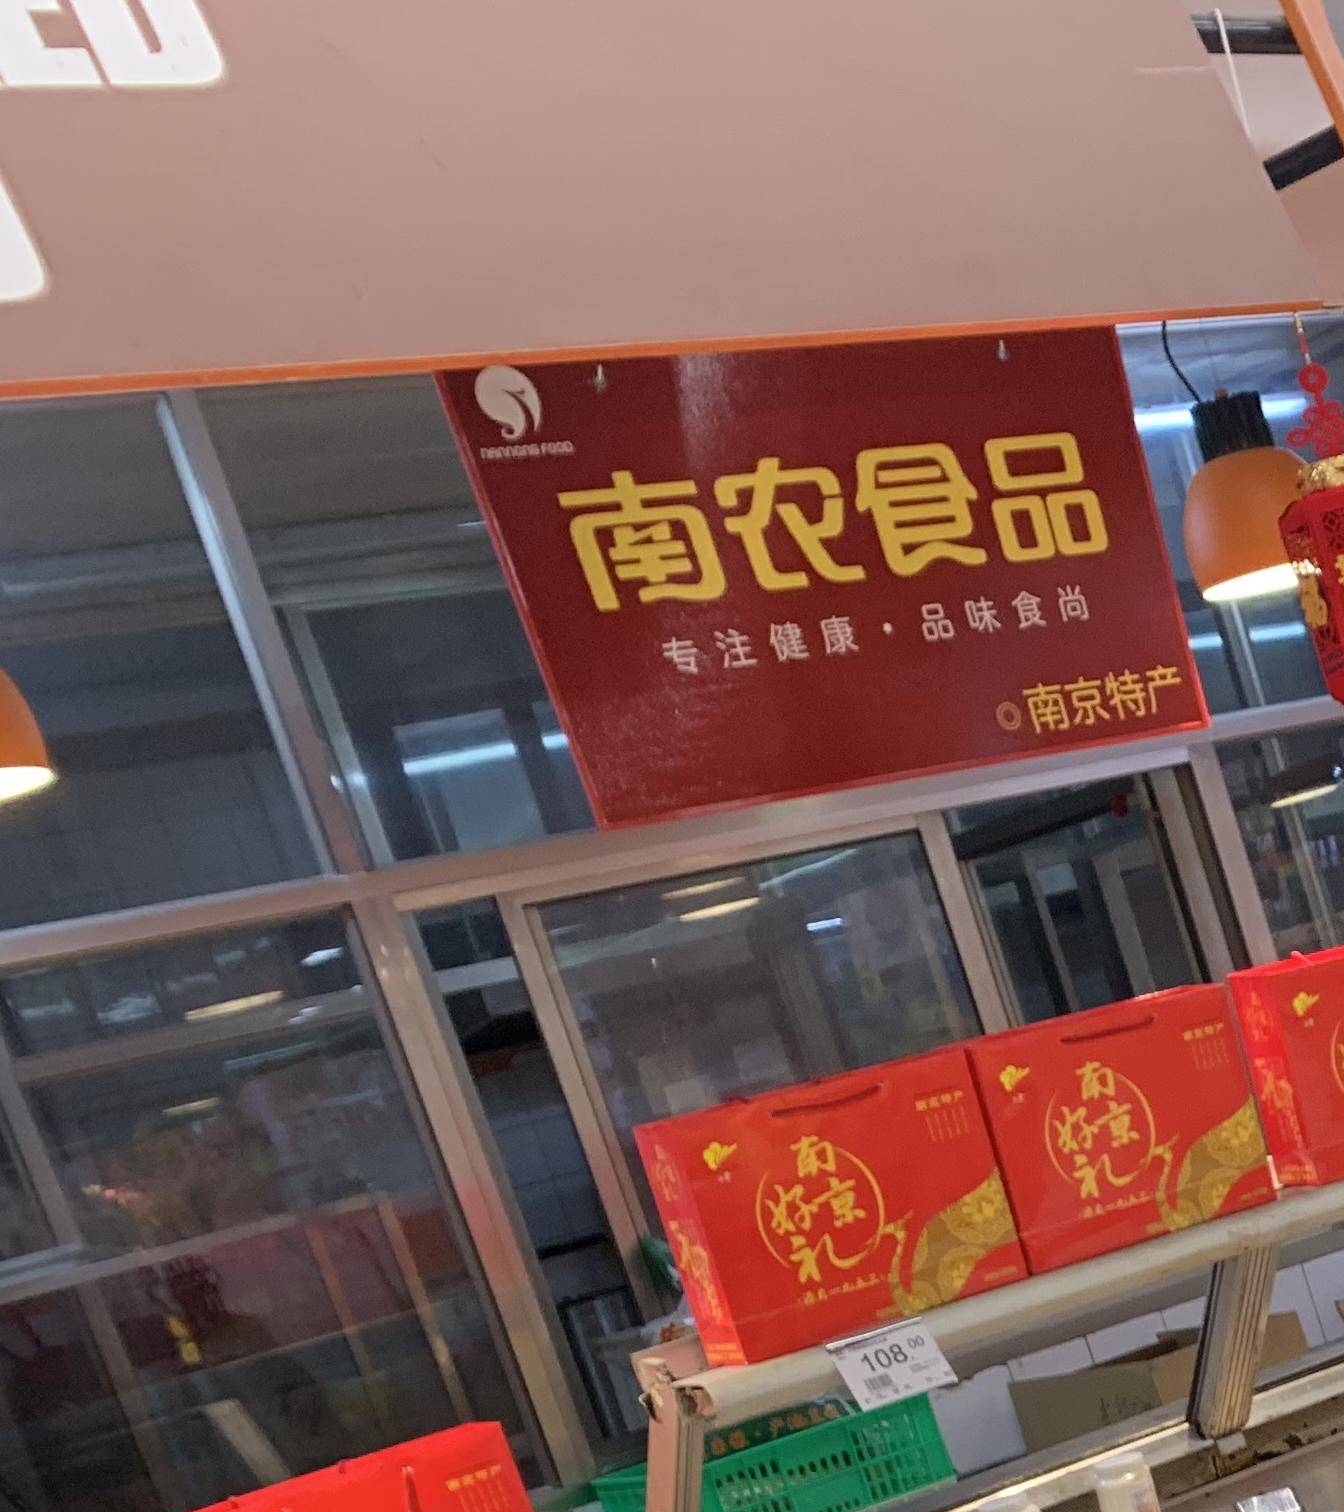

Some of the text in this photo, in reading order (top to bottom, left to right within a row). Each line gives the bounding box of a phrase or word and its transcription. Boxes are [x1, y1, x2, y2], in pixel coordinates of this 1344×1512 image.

[540, 440, 575, 454] FOOD
[557, 432, 1109, 612] 南农食品
[1022, 664, 1183, 734] 南京特产
